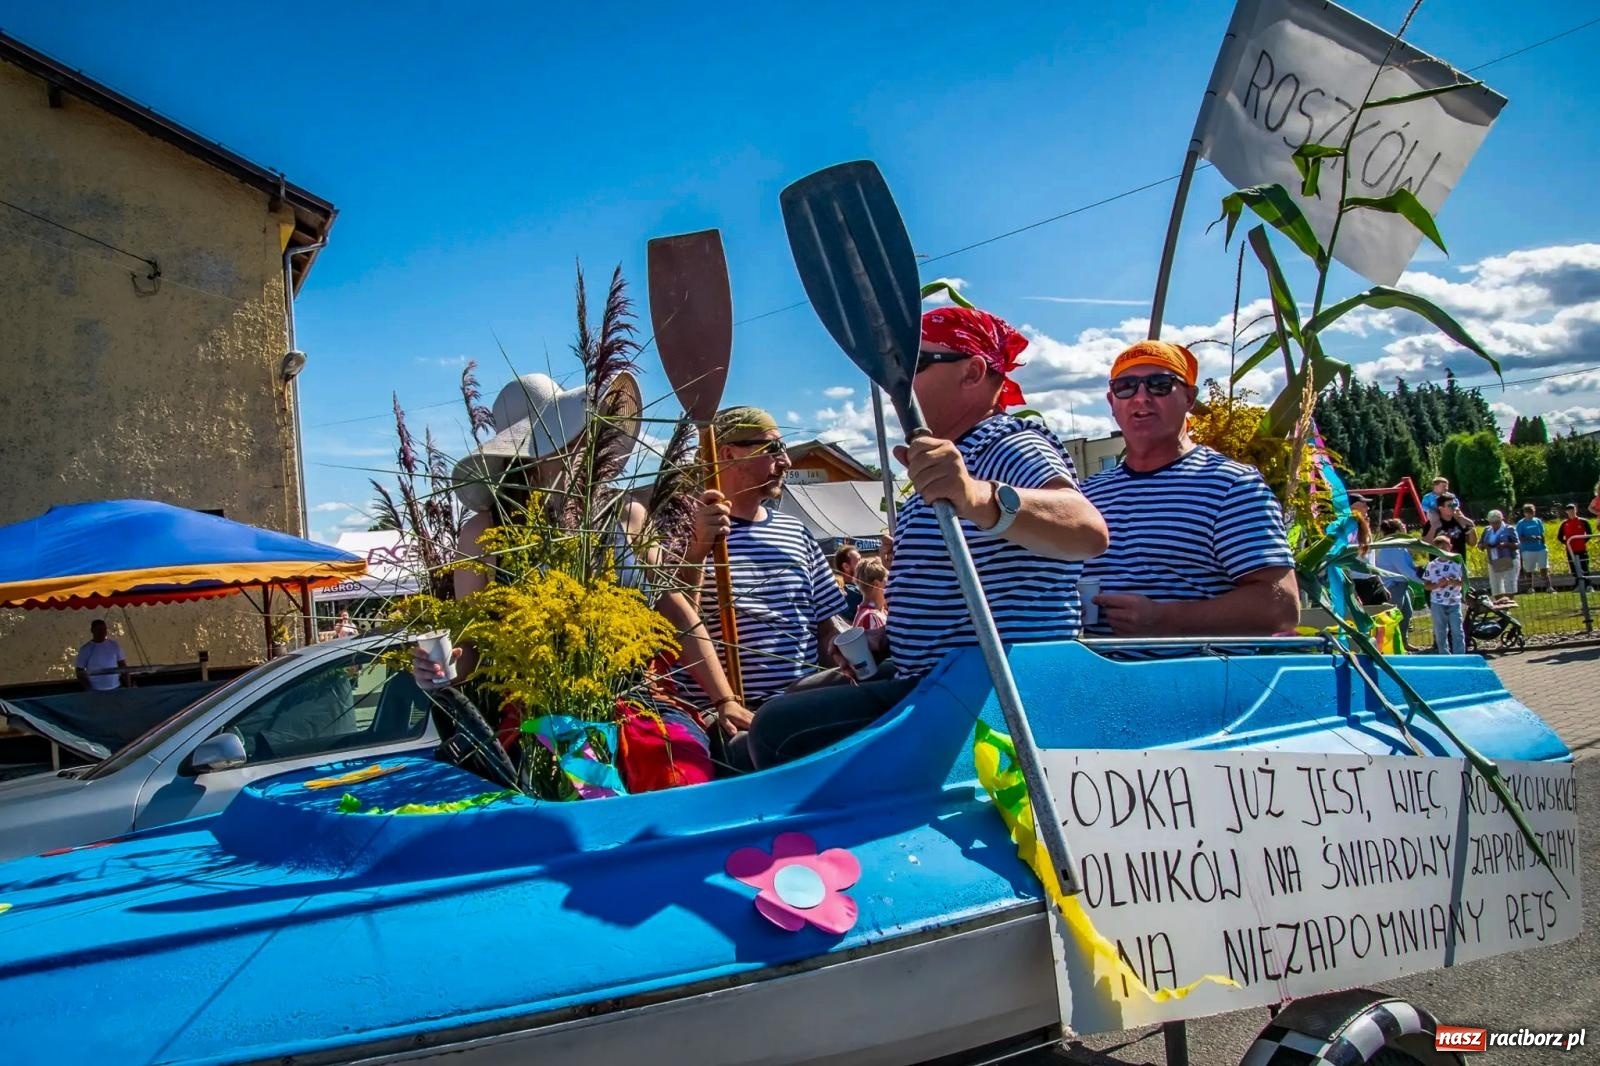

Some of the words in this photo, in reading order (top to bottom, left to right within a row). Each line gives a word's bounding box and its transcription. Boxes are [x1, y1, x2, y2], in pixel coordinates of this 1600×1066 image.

[1243, 49, 1441, 198] ROSZKÓW
[321, 582, 362, 594] AGROS
[1043, 756, 1196, 831] ÓDKA
[1214, 757, 1285, 834] JUŻ
[1296, 765, 1372, 827] JEST,
[1387, 768, 1448, 820] WIĘC,
[1060, 839, 1242, 912] OLNIKÓW
[1263, 845, 1302, 897] NA
[1321, 834, 1451, 890] ŚNIARDWY
[1116, 931, 1178, 999] NA
[1223, 898, 1484, 988] NIEZAPOMNIANY
[1505, 890, 1558, 942] REJS
